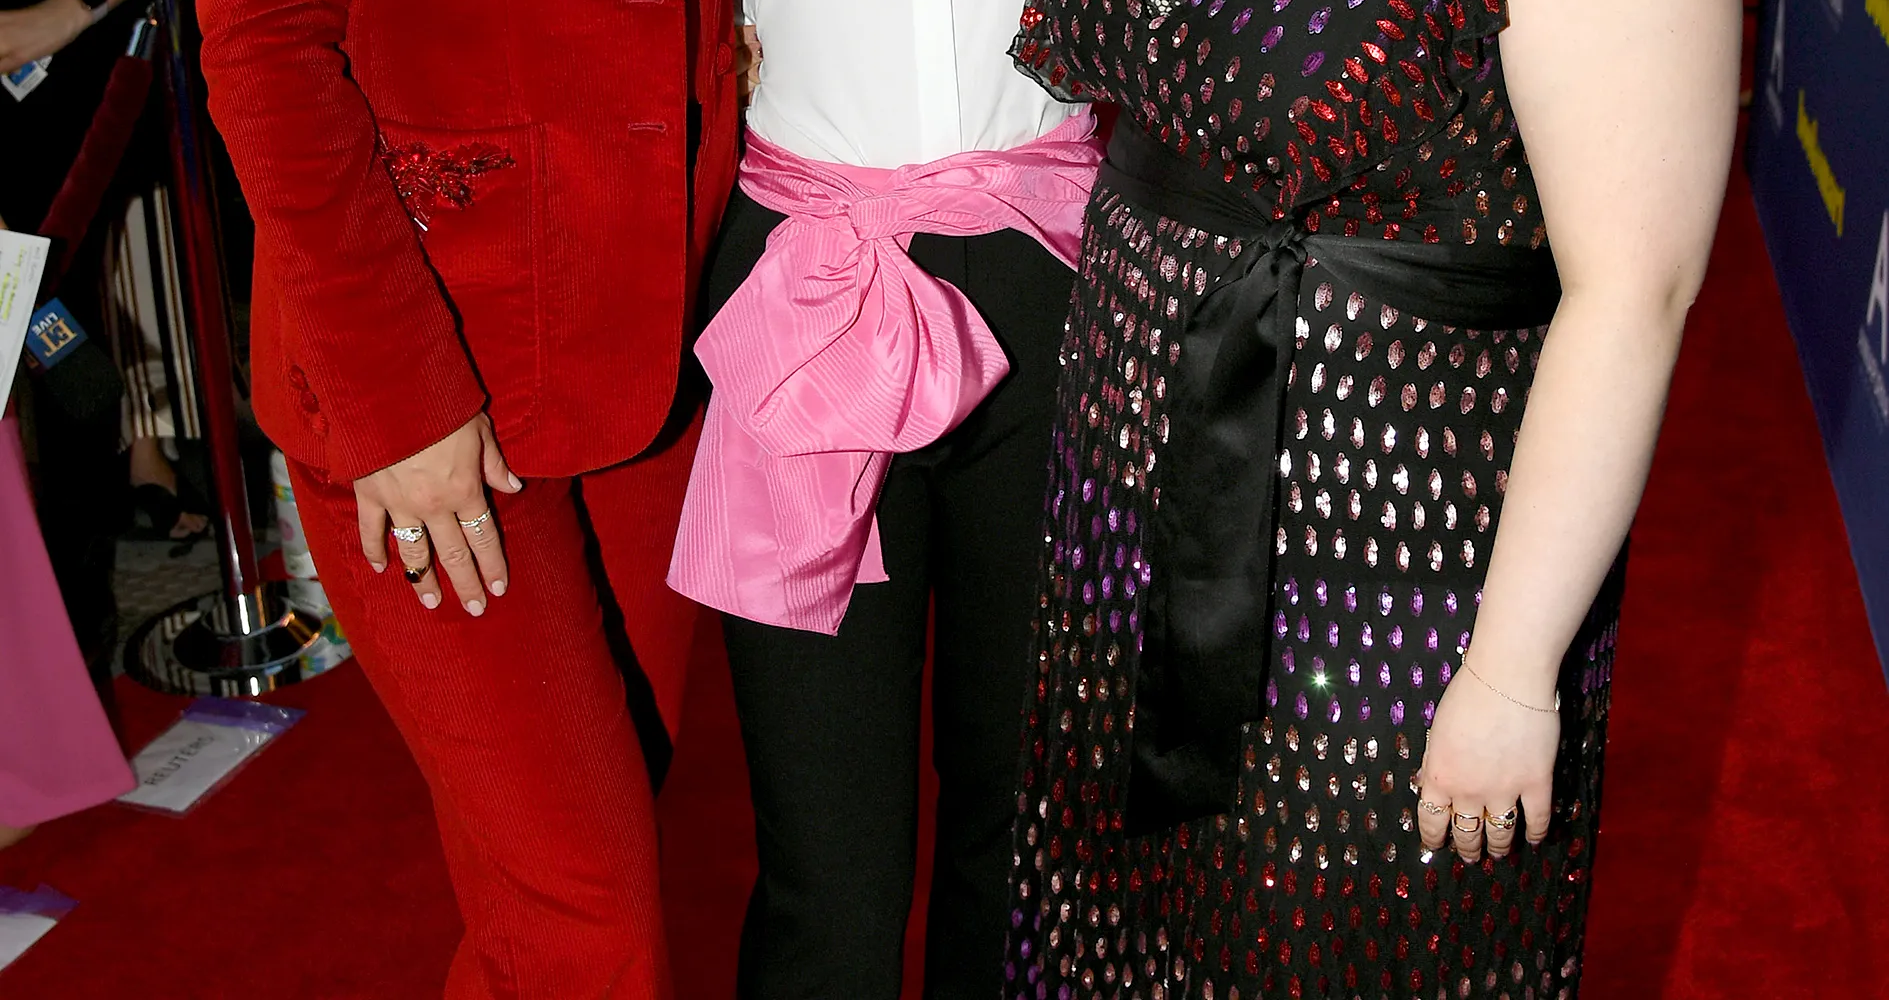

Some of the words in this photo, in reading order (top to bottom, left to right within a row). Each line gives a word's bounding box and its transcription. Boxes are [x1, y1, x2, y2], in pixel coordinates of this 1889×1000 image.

[32, 312, 58, 336] LIVE
[40, 317, 78, 357] ET
[144, 735, 215, 787] REUTERS
